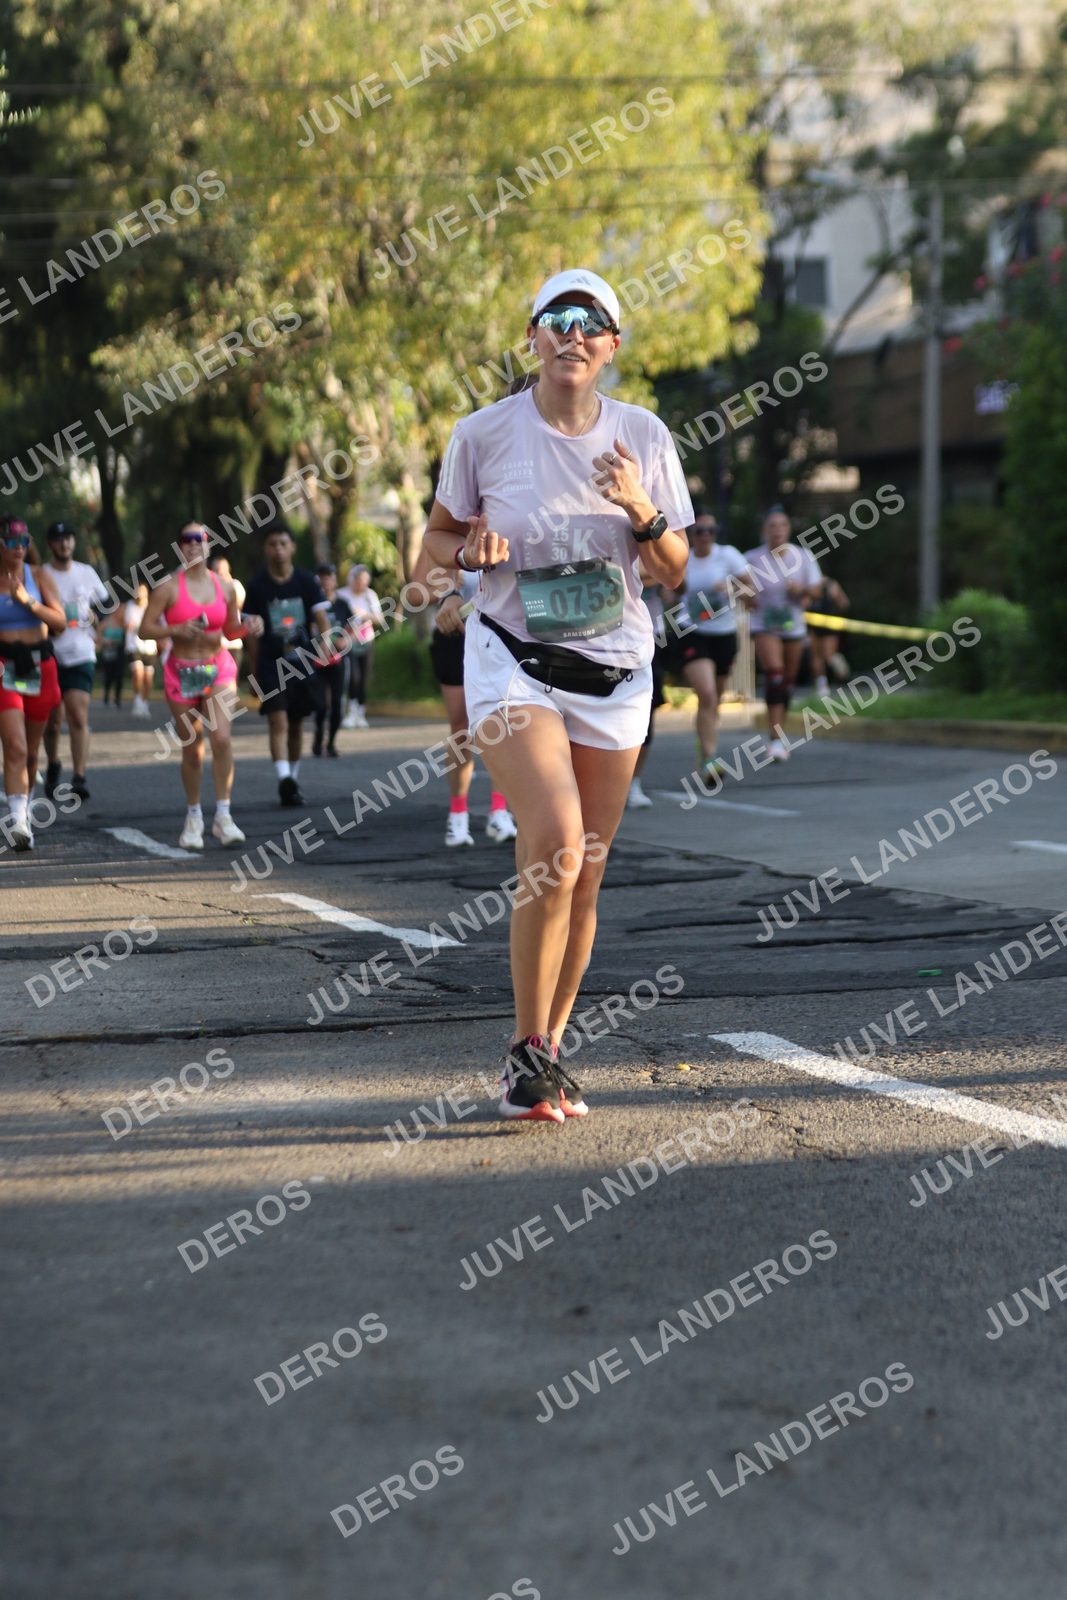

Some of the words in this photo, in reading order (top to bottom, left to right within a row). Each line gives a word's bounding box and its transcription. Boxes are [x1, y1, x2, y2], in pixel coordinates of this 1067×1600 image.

[552, 528, 569, 542] 15
[572, 528, 594, 561] K
[551, 547, 568, 562] 30
[550, 578, 620, 619] 0753
